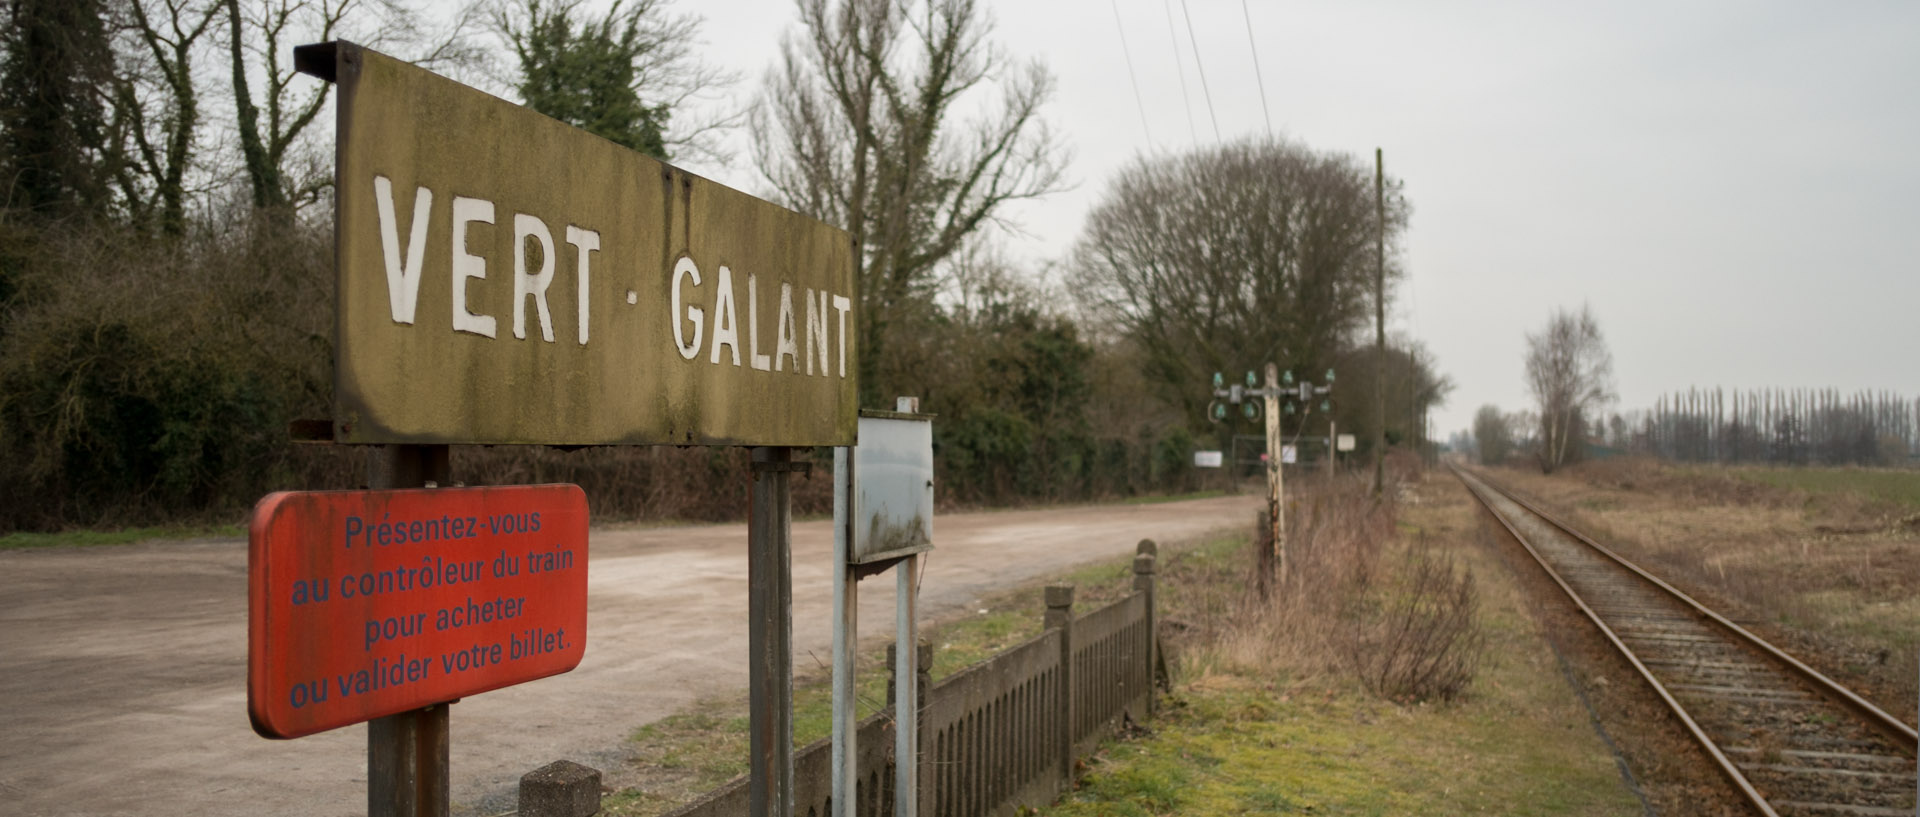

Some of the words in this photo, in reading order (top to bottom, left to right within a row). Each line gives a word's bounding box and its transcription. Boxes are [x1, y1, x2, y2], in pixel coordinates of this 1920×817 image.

[374, 175, 601, 345] VERT
[672, 256, 850, 378] GALANT
[345, 511, 541, 548] Présentez-vous
[291, 577, 329, 605] au
[341, 556, 485, 599] contrôleur
[493, 549, 519, 578] du
[527, 544, 574, 574] train
[365, 612, 427, 651] pour
[436, 597, 525, 631] acheter
[290, 677, 328, 709] ou
[338, 653, 432, 697] valider
[442, 642, 502, 674] votre
[510, 627, 571, 660] billet.
